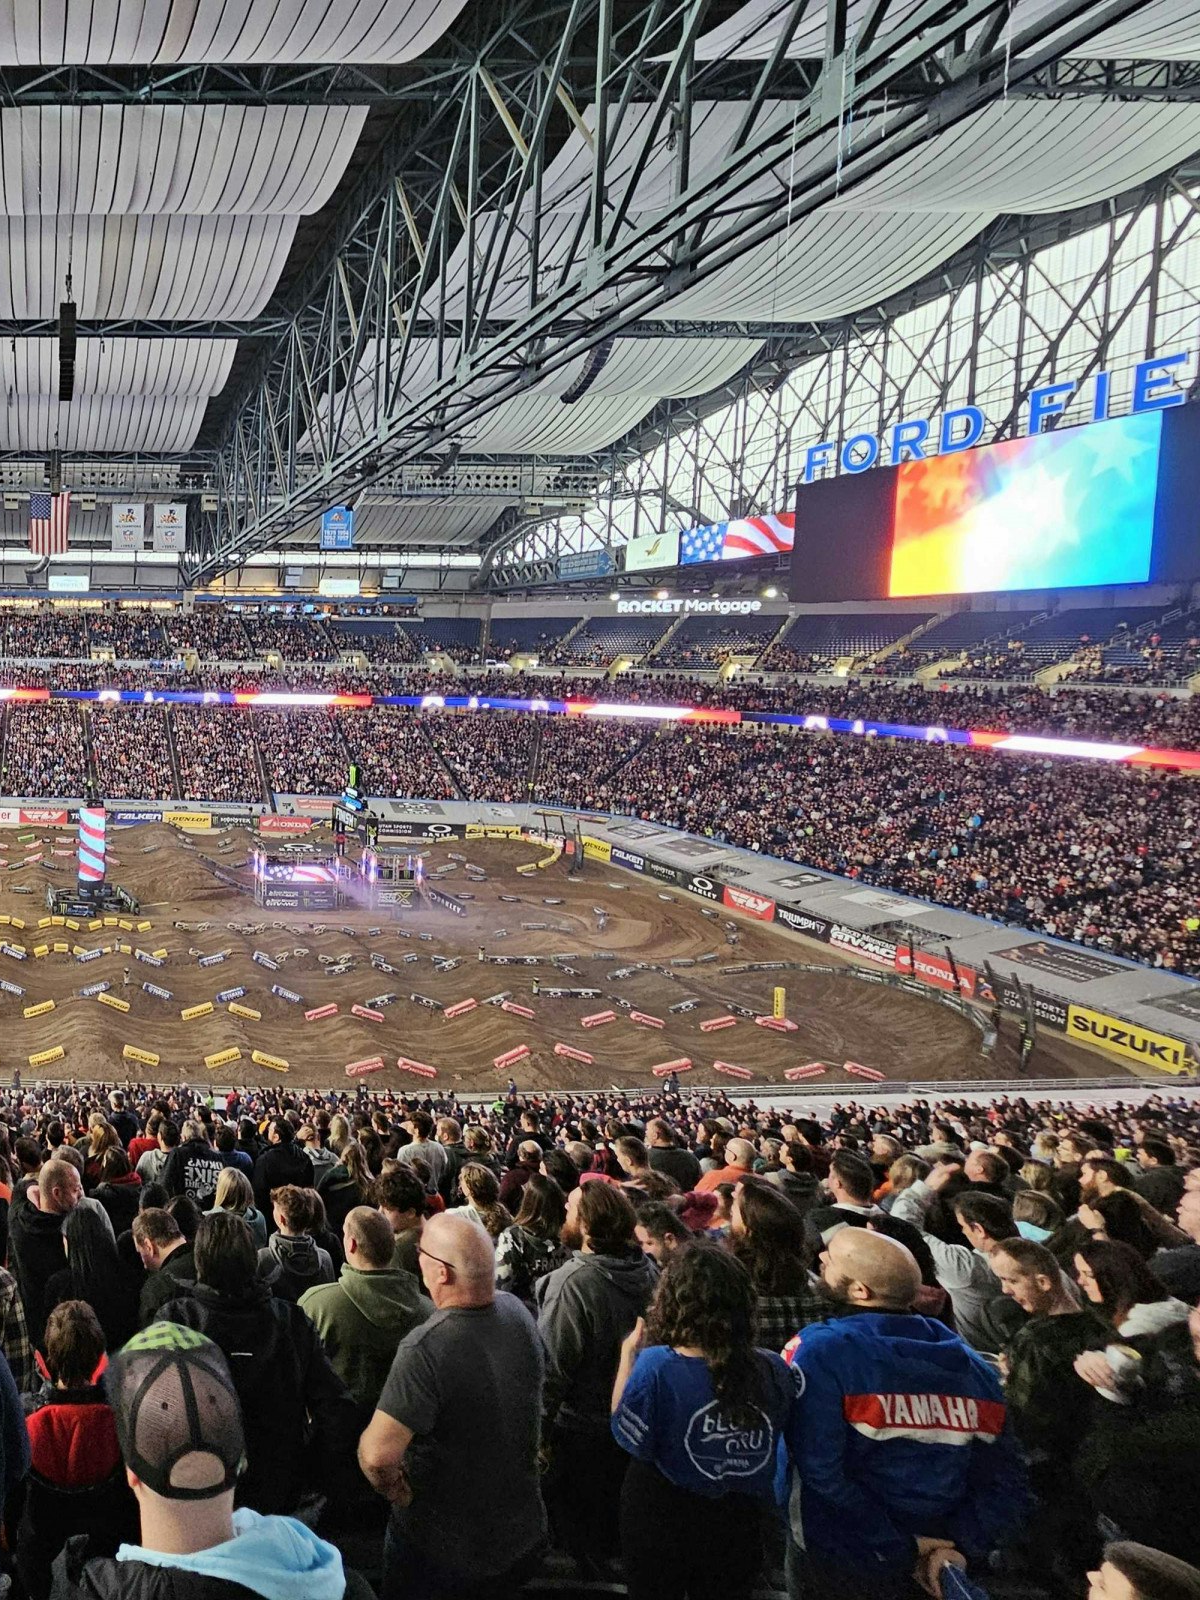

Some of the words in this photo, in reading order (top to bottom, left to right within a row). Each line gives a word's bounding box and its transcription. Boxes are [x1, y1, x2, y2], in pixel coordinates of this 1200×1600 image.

[804, 404, 987, 484] FORD
[617, 599, 683, 614] ROCKET
[684, 599, 762, 615] Mortgage
[117, 812, 162, 820] FALKEN
[220, 816, 251, 824] MONSTER
[273, 821, 311, 829] HONDA
[584, 841, 610, 854] DUNLOP
[612, 848, 644, 866] FALKEN
[650, 863, 676, 878] MONSTER
[688, 884, 717, 901] OAKLEY
[778, 908, 816, 930] TRIUMPH
[841, 925, 861, 939] ROCKY
[861, 933, 897, 951] MOUNTAIN
[1071, 1014, 1180, 1066] SUZUKI
[214, 1052, 240, 1064] DUNLOP
[184, 1166, 220, 1185] BIKE
[877, 1393, 979, 1429] YAMAHA
